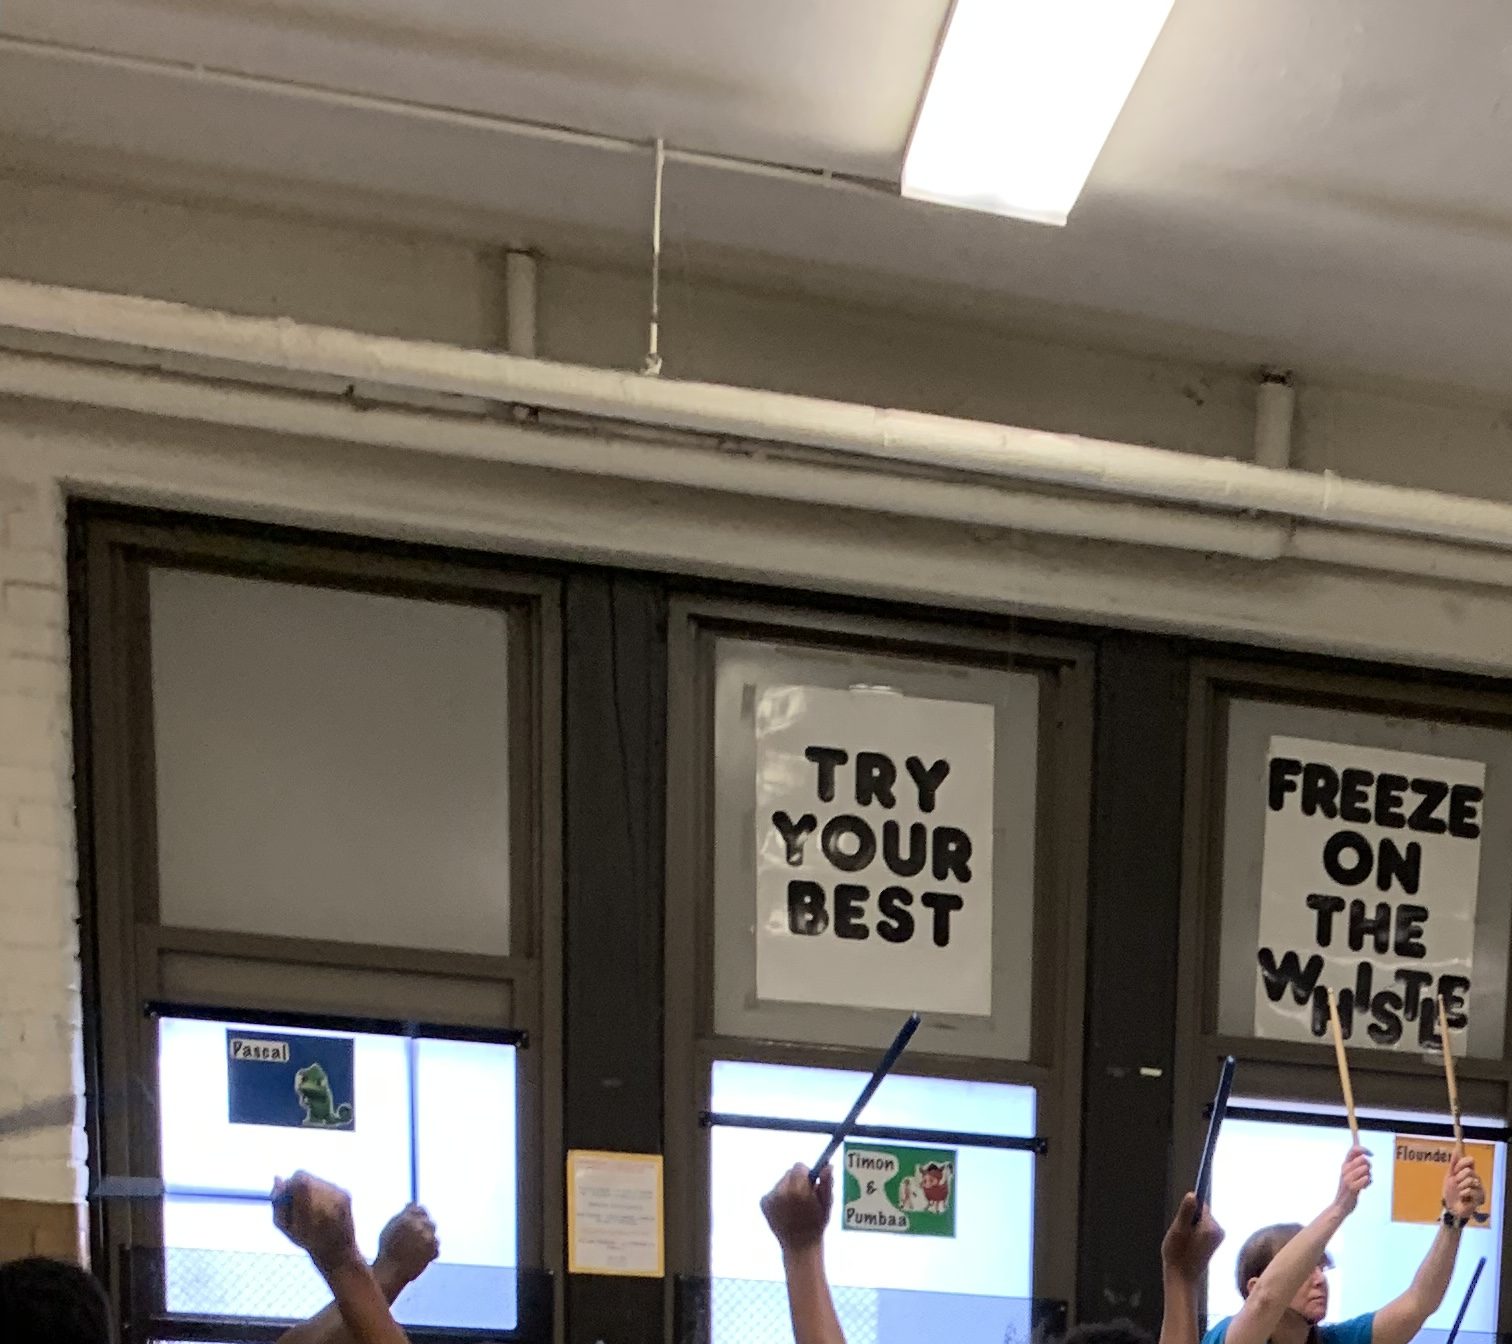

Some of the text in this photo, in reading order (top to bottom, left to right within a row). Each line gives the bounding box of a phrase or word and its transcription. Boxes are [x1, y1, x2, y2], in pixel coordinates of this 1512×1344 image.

[804, 745, 950, 813] TRY
[1268, 757, 1484, 839] FREEZE
[772, 810, 973, 883] YOUR
[1322, 830, 1422, 895] ON
[787, 880, 964, 947] BEST
[1306, 893, 1429, 959] THE
[232, 1040, 287, 1061] Pascal
[847, 1151, 896, 1171] Timon
[846, 1207, 907, 1227] Pumbaa
